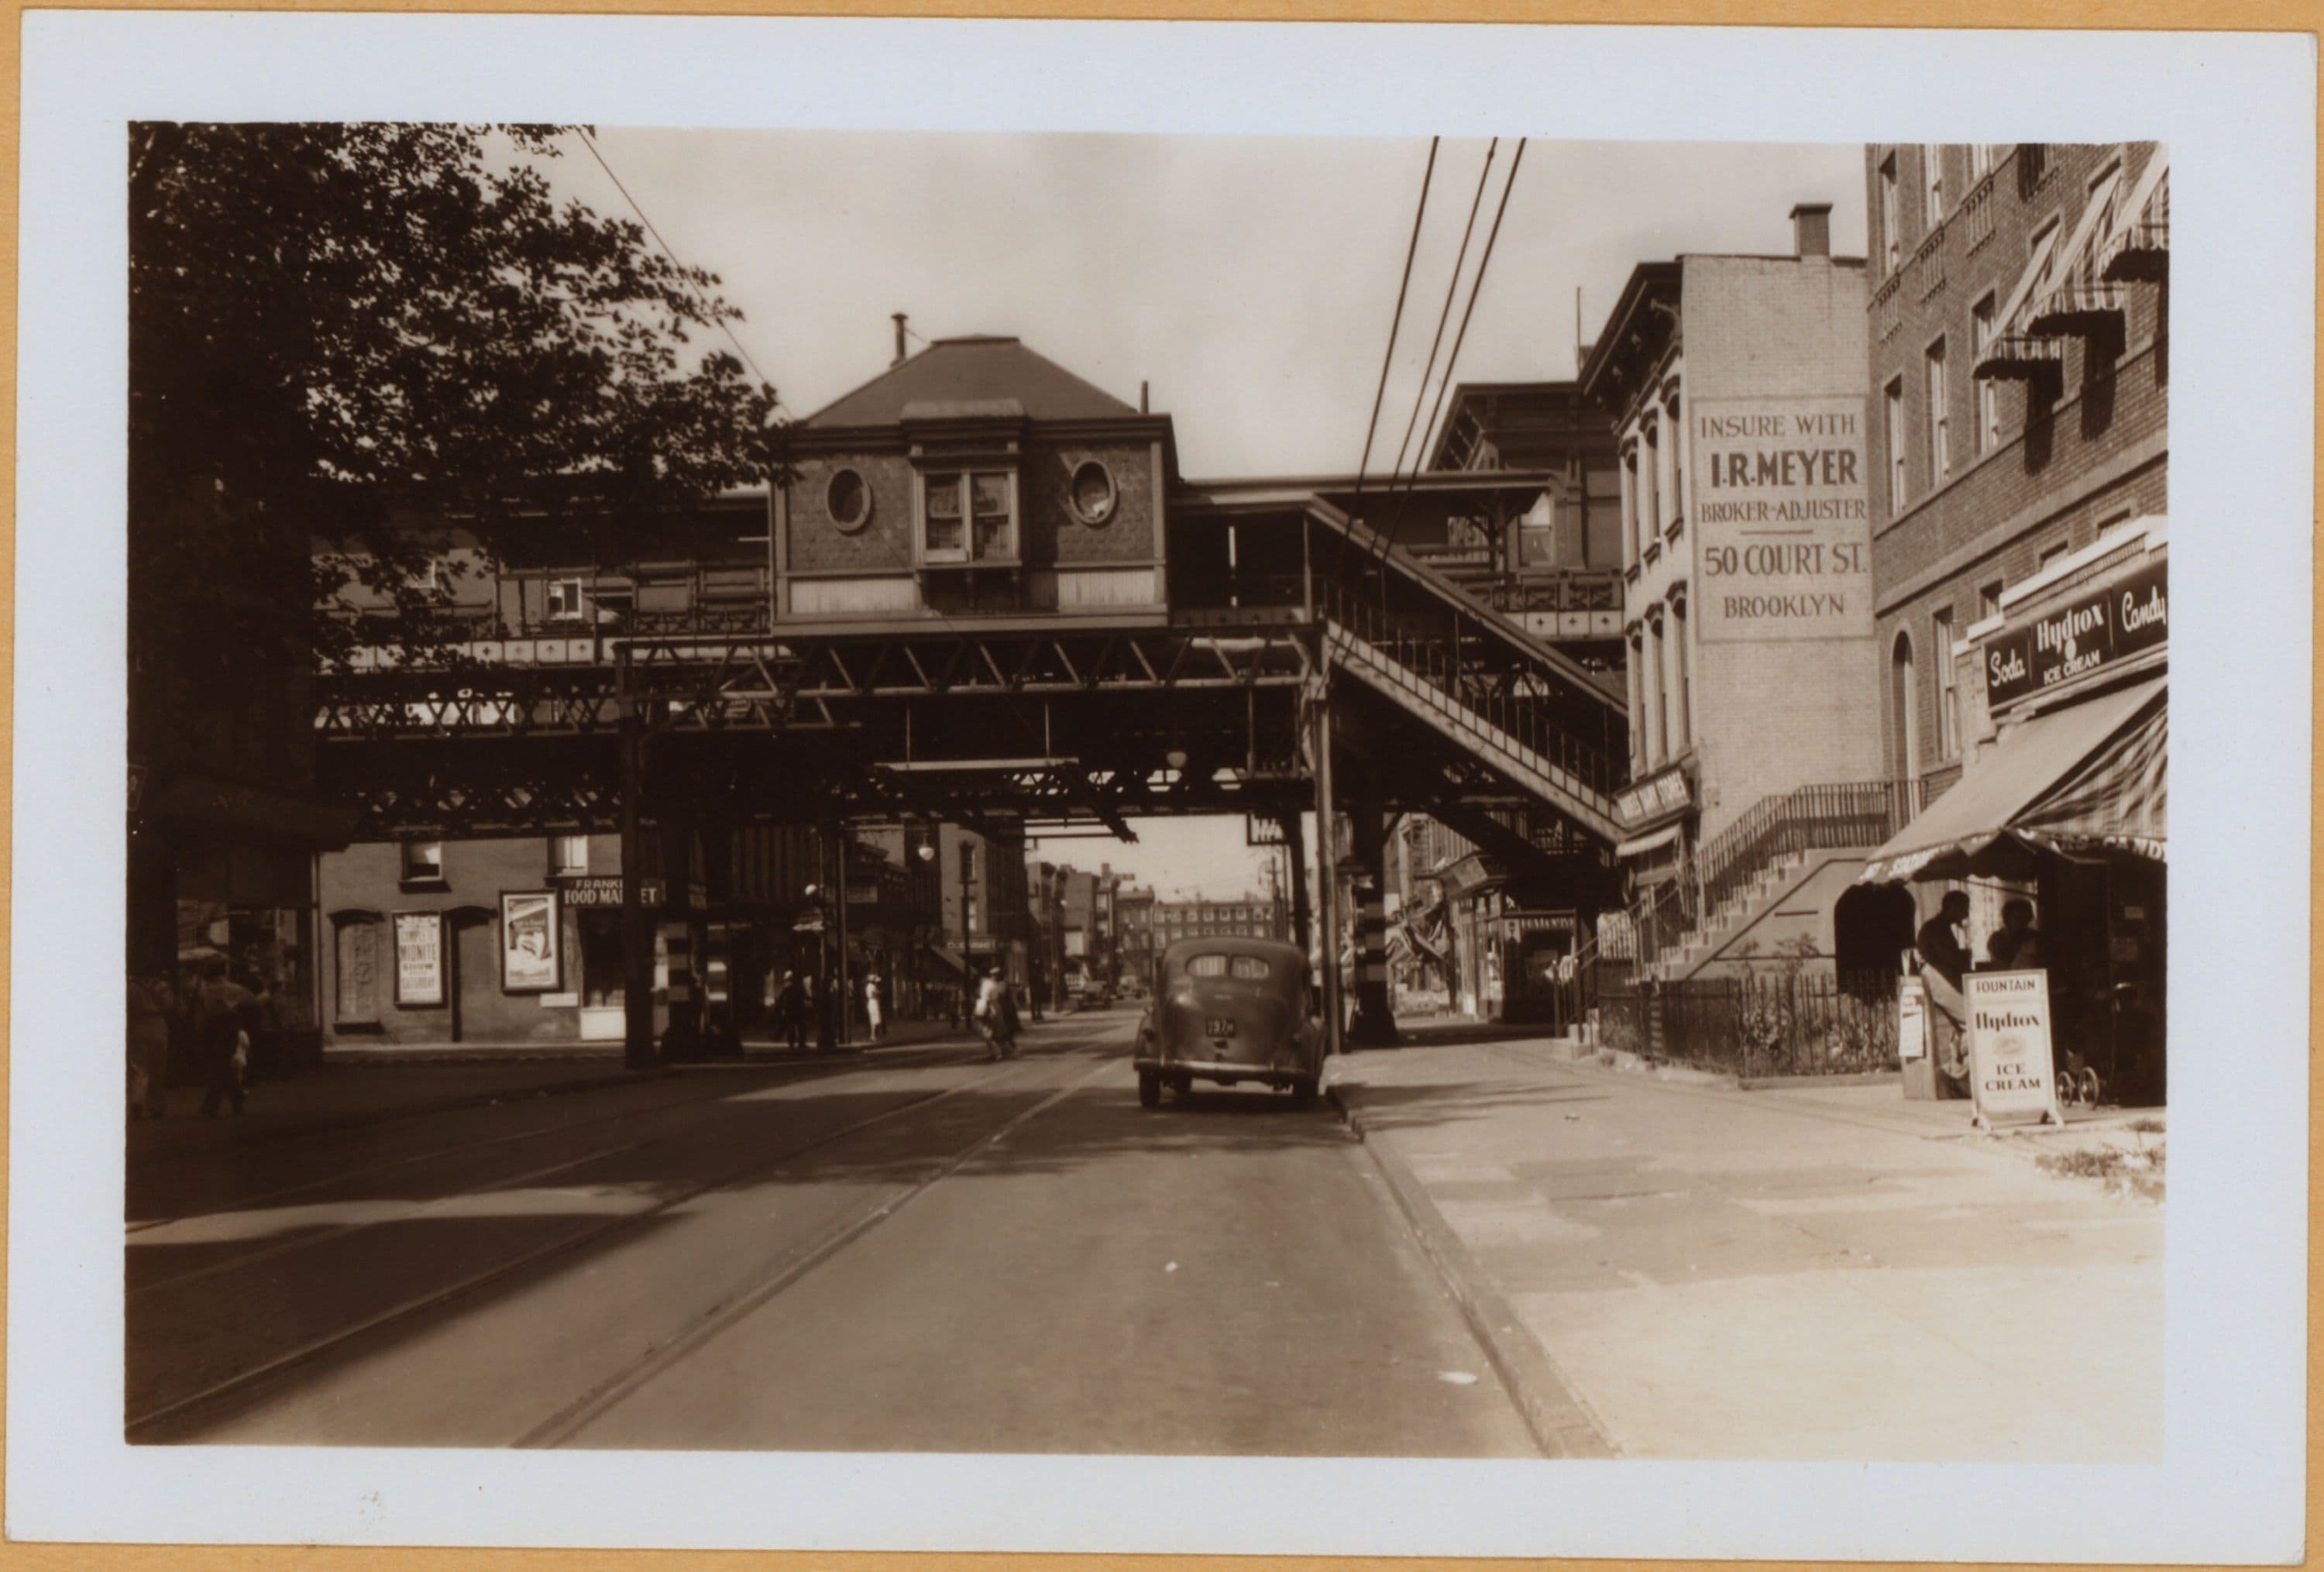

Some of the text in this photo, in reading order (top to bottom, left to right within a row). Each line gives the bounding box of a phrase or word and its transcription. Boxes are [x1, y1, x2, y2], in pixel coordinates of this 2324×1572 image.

[1701, 413, 1855, 439] INSURE WITH
[1705, 542, 1867, 576] 50 COURT ST.
[1724, 594, 1844, 618] BROOKLYN
[2121, 585, 2167, 632] Candy
[2037, 604, 2104, 654] Hydrox
[1990, 648, 2026, 687] Soda
[2044, 649, 2101, 685] ICE CREAM
[564, 889, 596, 905] FOOD
[1975, 979, 2036, 993] FOUNTAIN
[1975, 1011, 2040, 1033] Hydrox
[1996, 1062, 2027, 1075] ICE
[1985, 1078, 2040, 1092] CREAM
